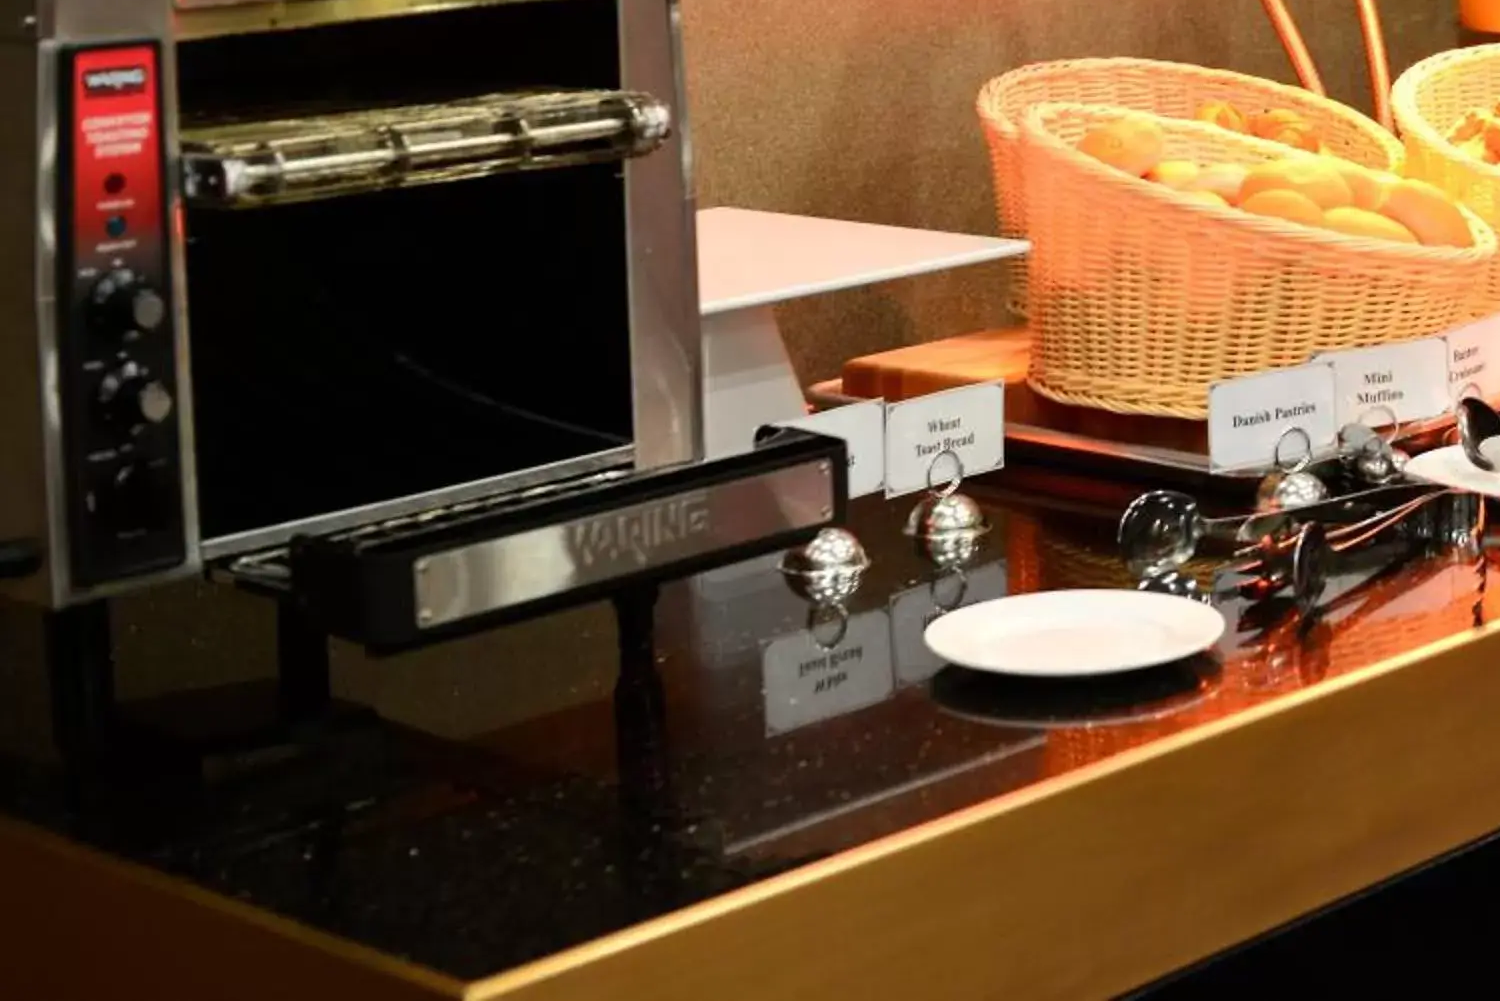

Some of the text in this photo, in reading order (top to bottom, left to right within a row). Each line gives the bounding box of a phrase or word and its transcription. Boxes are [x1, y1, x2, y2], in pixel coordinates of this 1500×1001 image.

[1364, 370, 1393, 385] Mini
[1357, 389, 1404, 406] Muffins
[1232, 401, 1316, 429] Danish Pastries
[927, 417, 961, 433] Wheat
[916, 432, 974, 458] Toast Bread
